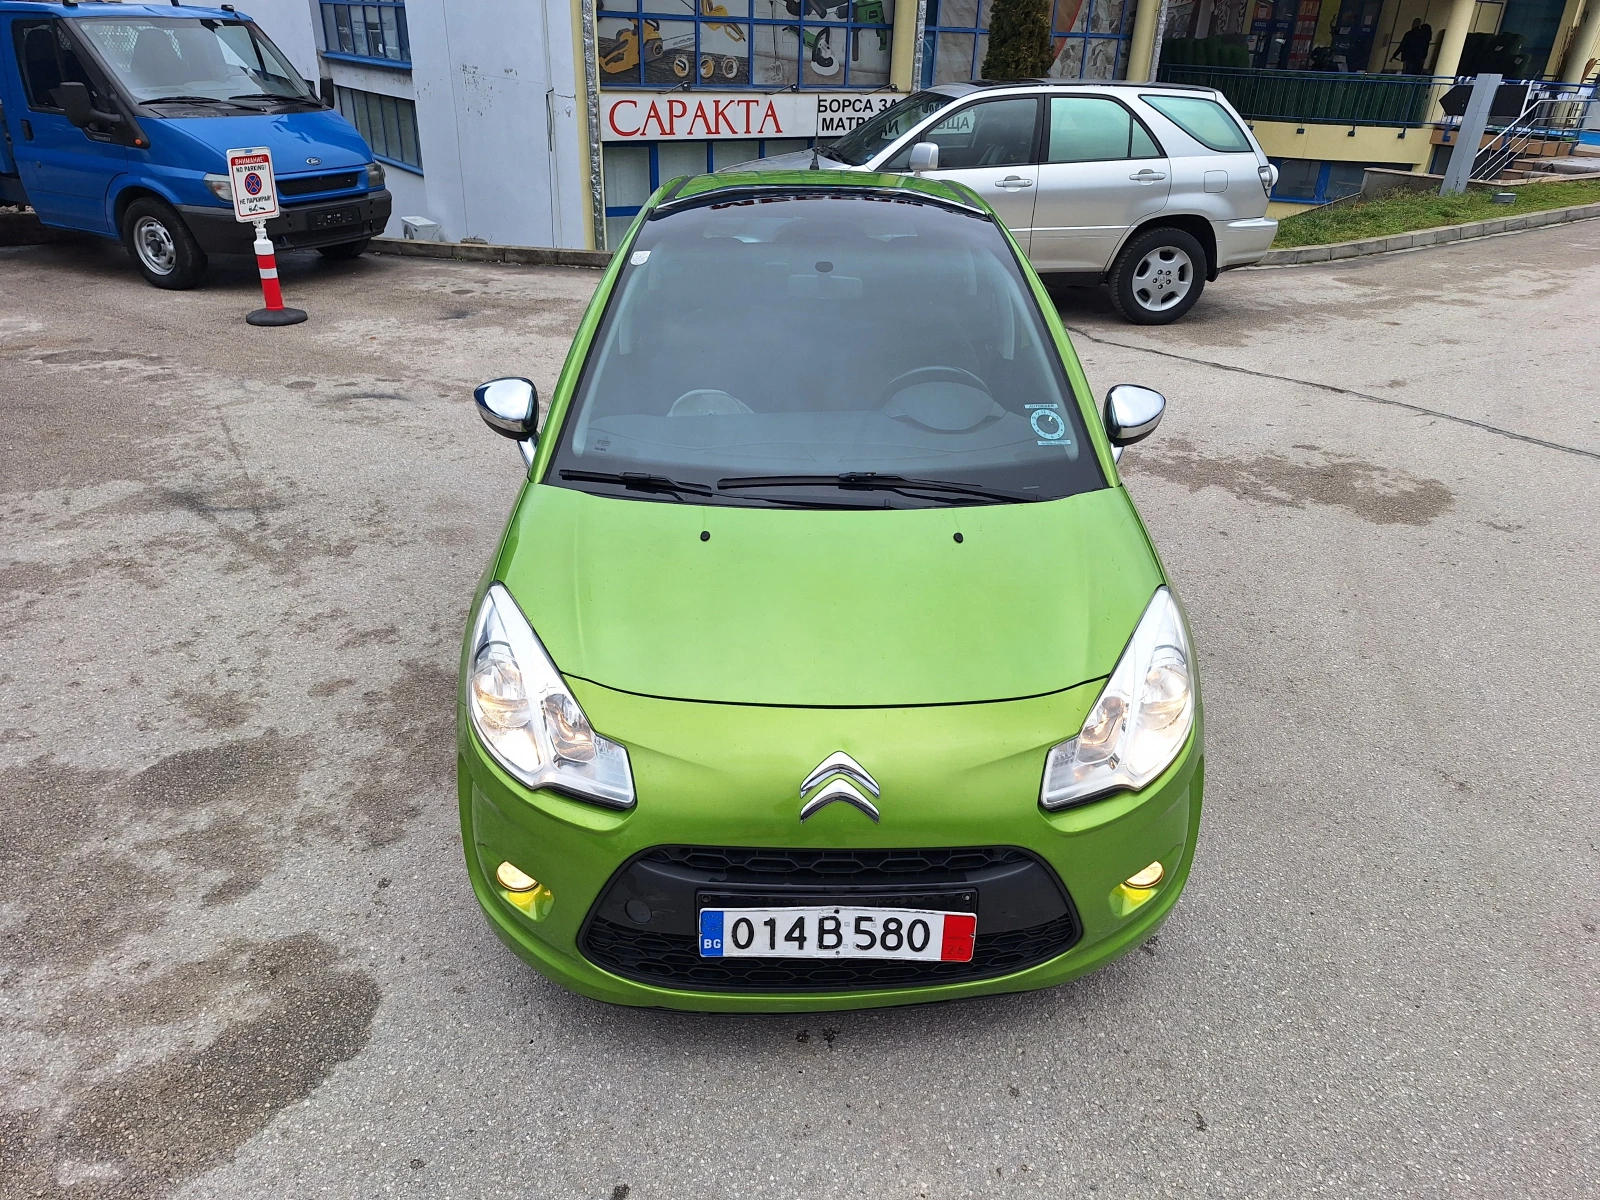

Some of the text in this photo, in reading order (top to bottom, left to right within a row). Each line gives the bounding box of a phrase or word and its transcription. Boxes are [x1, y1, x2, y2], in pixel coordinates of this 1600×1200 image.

[817, 99, 874, 113] БОРСА
[609, 99, 784, 137] САРАКТА
[235, 156, 265, 165] ВНИМАНИЕ!
[244, 164, 267, 172] PARKING!
[731, 915, 931, 953] 014B580
[703, 938, 722, 950] BG
